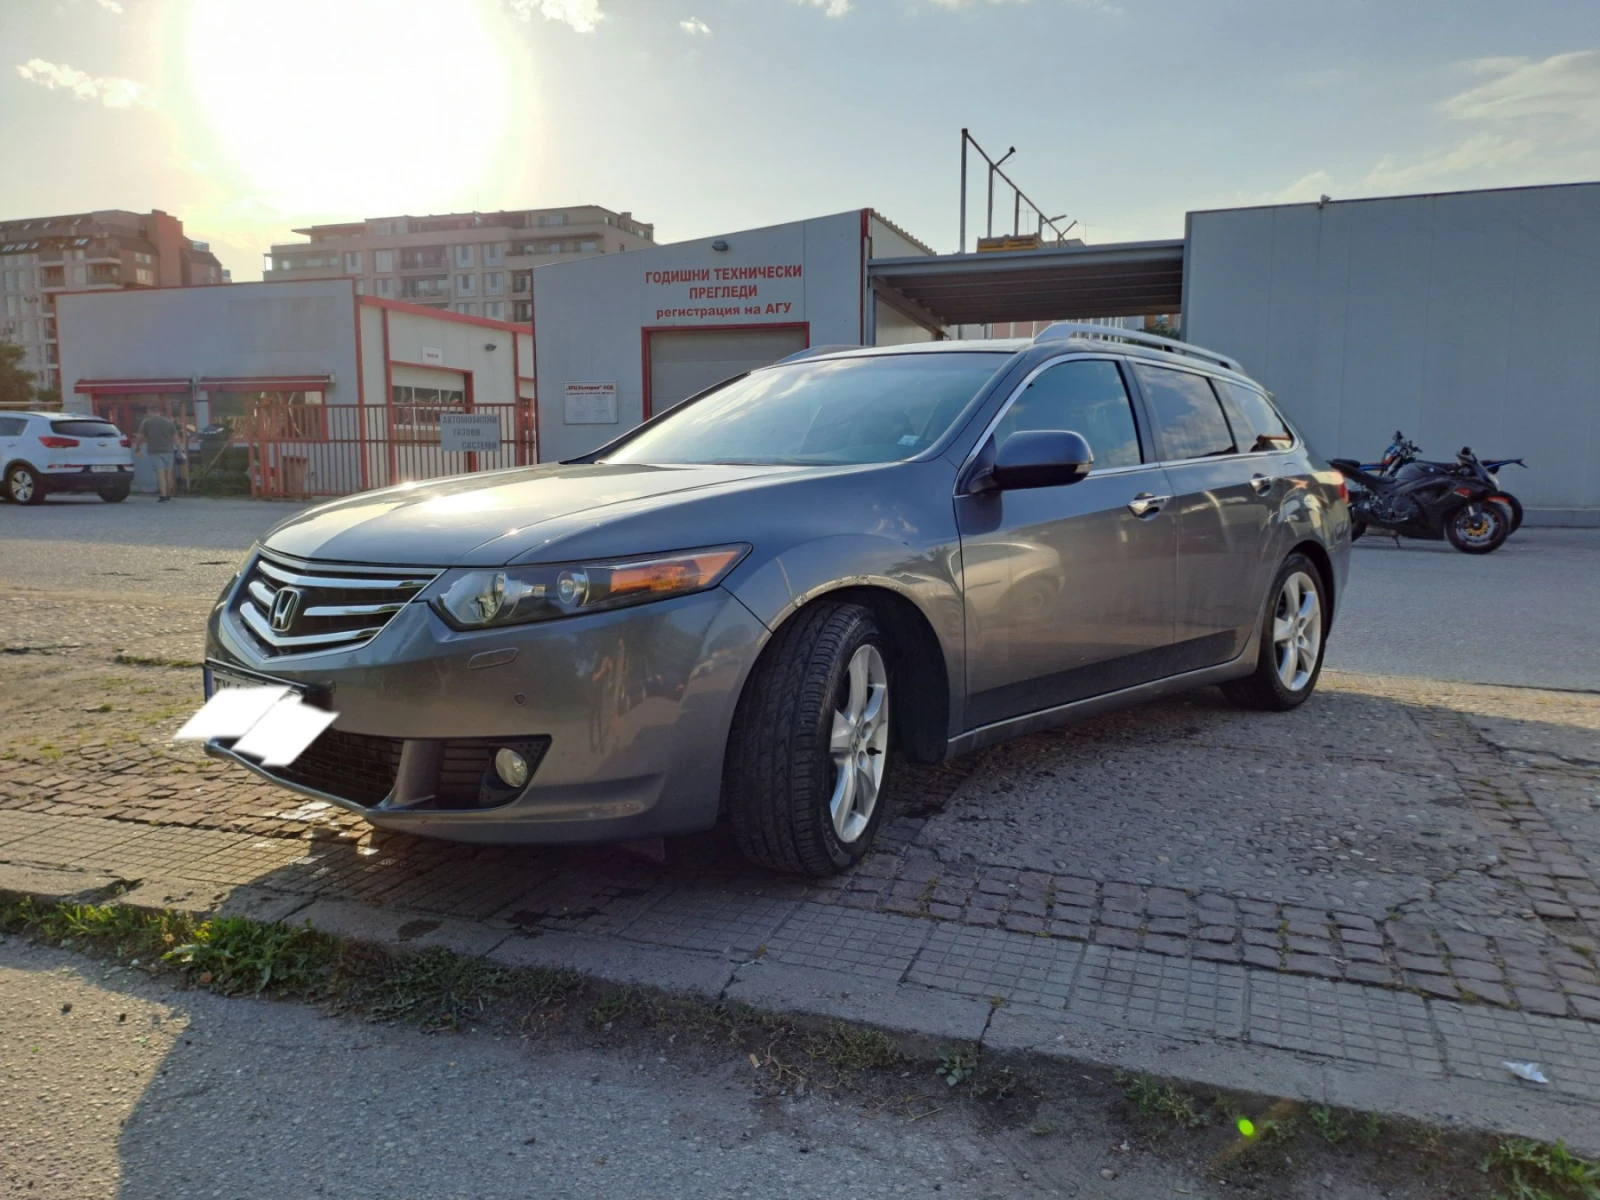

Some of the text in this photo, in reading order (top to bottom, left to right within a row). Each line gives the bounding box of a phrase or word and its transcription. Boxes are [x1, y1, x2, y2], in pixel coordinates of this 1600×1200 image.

[645, 265, 802, 285] ГОДИШНИ ТЕХНИЧЕСКИ
[689, 285, 758, 300] ПРЕГЛЕДИ
[656, 302, 792, 320] регистрация на АГУ
[442, 415, 498, 425] АВТОМОБИЛНИ
[453, 427, 481, 437] ГАЗОВИ
[461, 440, 497, 450] СИСТЕМИ
